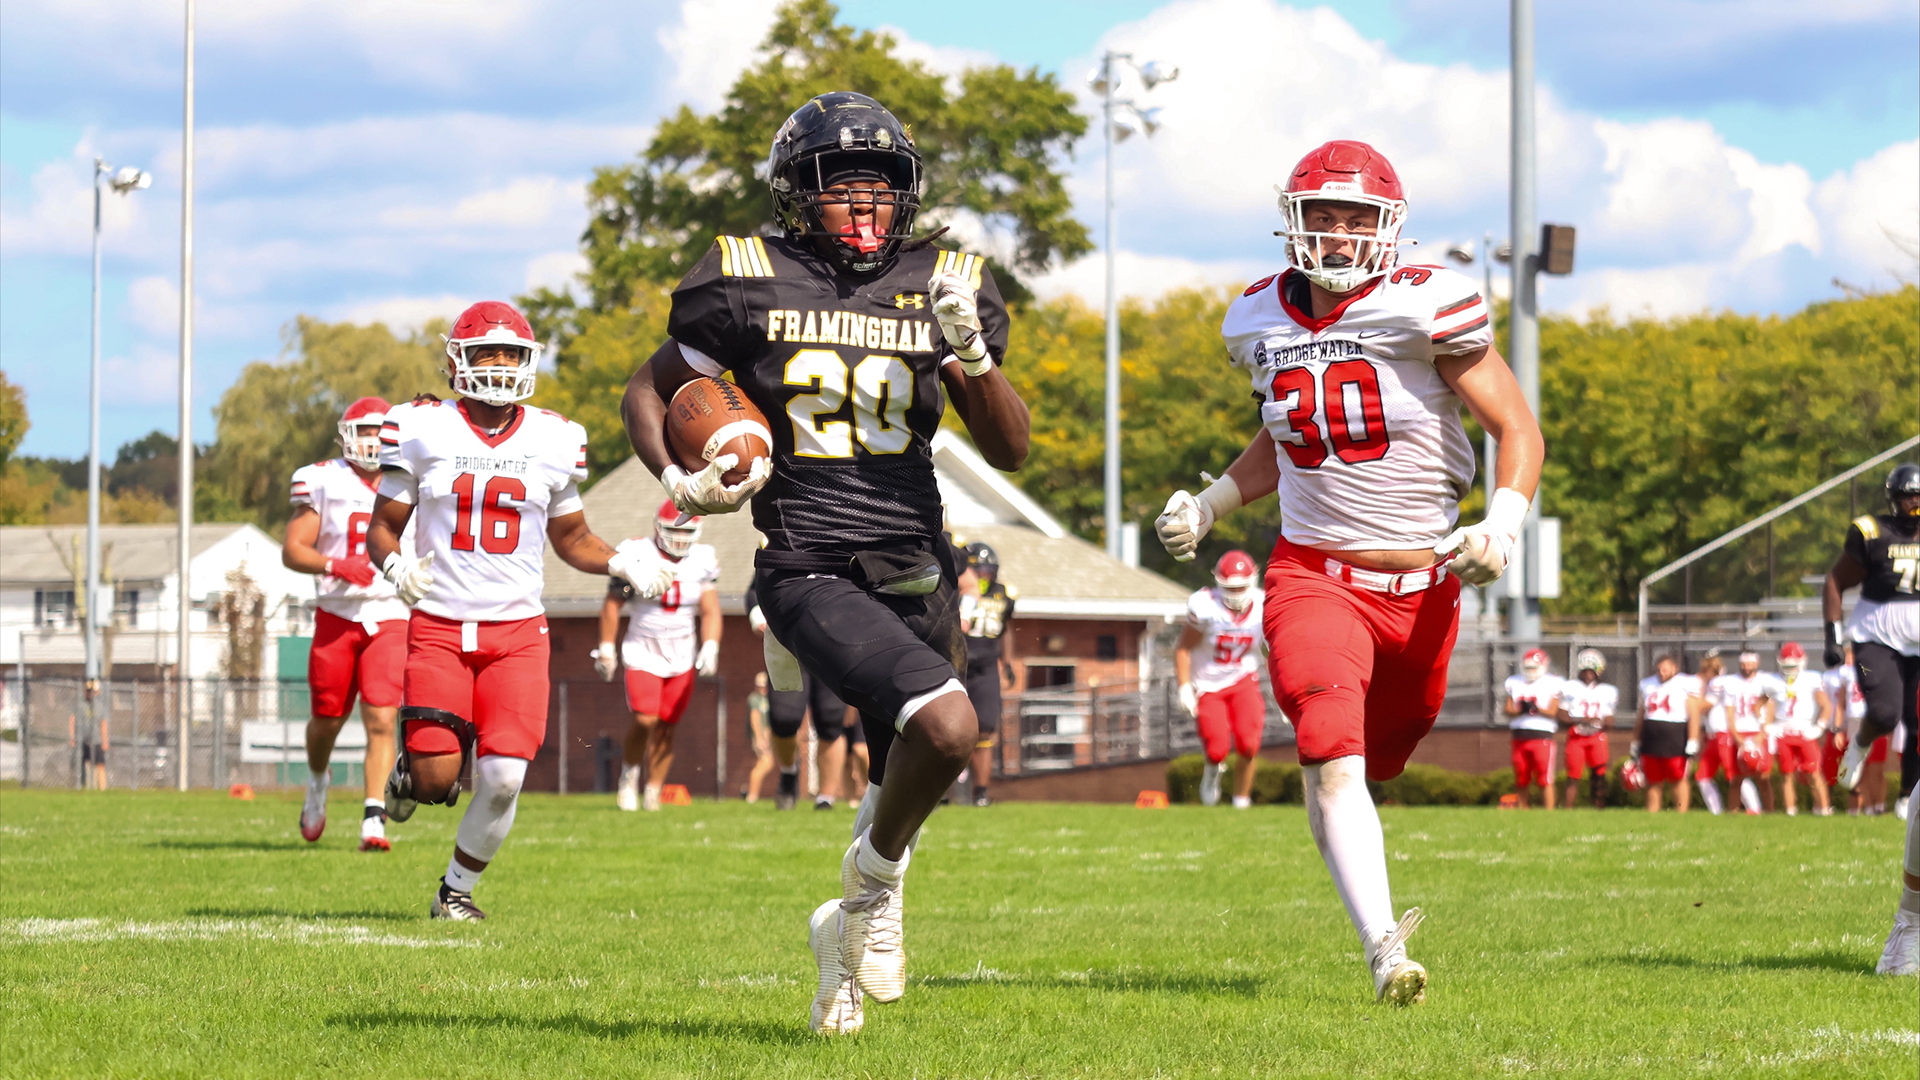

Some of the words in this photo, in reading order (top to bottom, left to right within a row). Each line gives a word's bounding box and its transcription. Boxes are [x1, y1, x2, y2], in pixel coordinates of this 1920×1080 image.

[765, 310, 934, 351] FRAMINGHAM
[1273, 340, 1364, 367] BRIDGEWATER
[783, 349, 914, 458] 20
[1271, 359, 1390, 468] 30
[455, 456, 527, 474] BRIDGEWATER
[451, 472, 526, 554] 16
[1893, 559, 1919, 594] 7
[1214, 635, 1253, 664] 57
